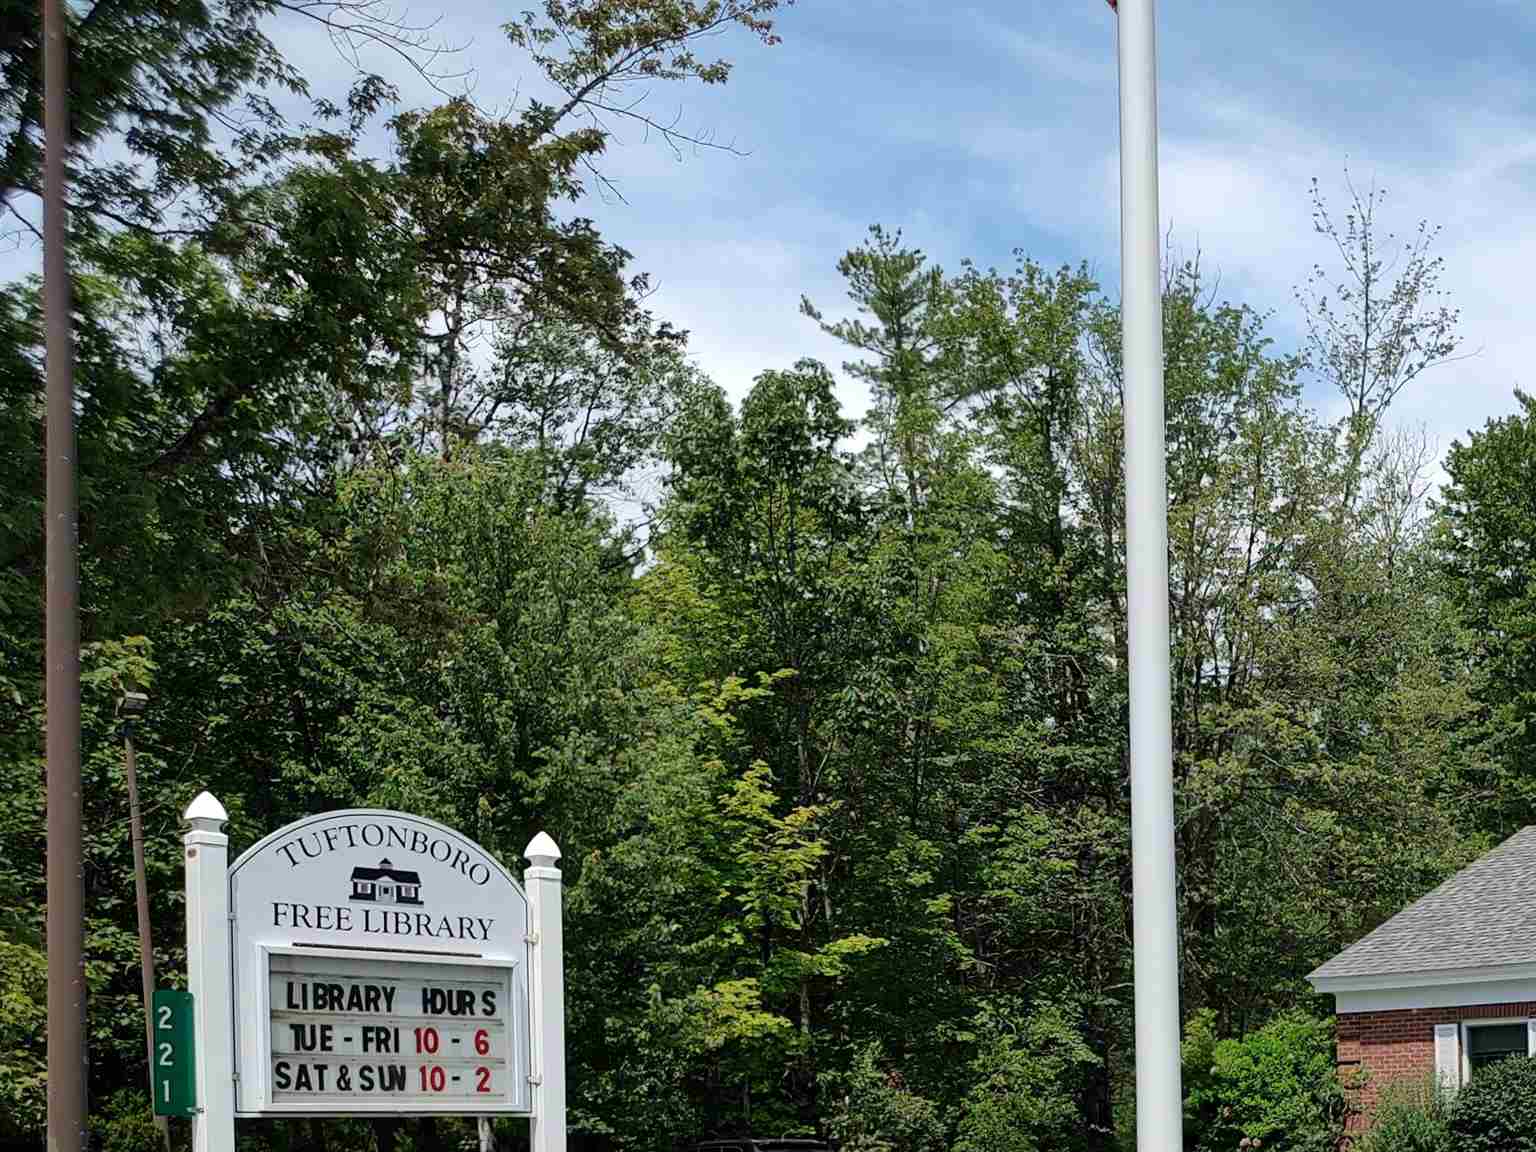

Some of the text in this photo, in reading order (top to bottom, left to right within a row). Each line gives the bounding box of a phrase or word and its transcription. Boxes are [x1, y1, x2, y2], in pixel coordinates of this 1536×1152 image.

[275, 823, 492, 887] TUFTONBORO
[271, 901, 496, 941] FREE LIBRARY
[286, 982, 496, 1016] LIBRARY HOURS
[290, 1023, 333, 1052] TUE
[361, 1026, 399, 1053] FRI
[414, 1027, 439, 1054] 10
[474, 1029, 490, 1055] 6
[275, 1061, 328, 1091] SAT
[336, 1064, 352, 1091] &
[359, 1065, 406, 1092] SUN
[419, 1065, 446, 1092] 10
[475, 1067, 490, 1092] 2
